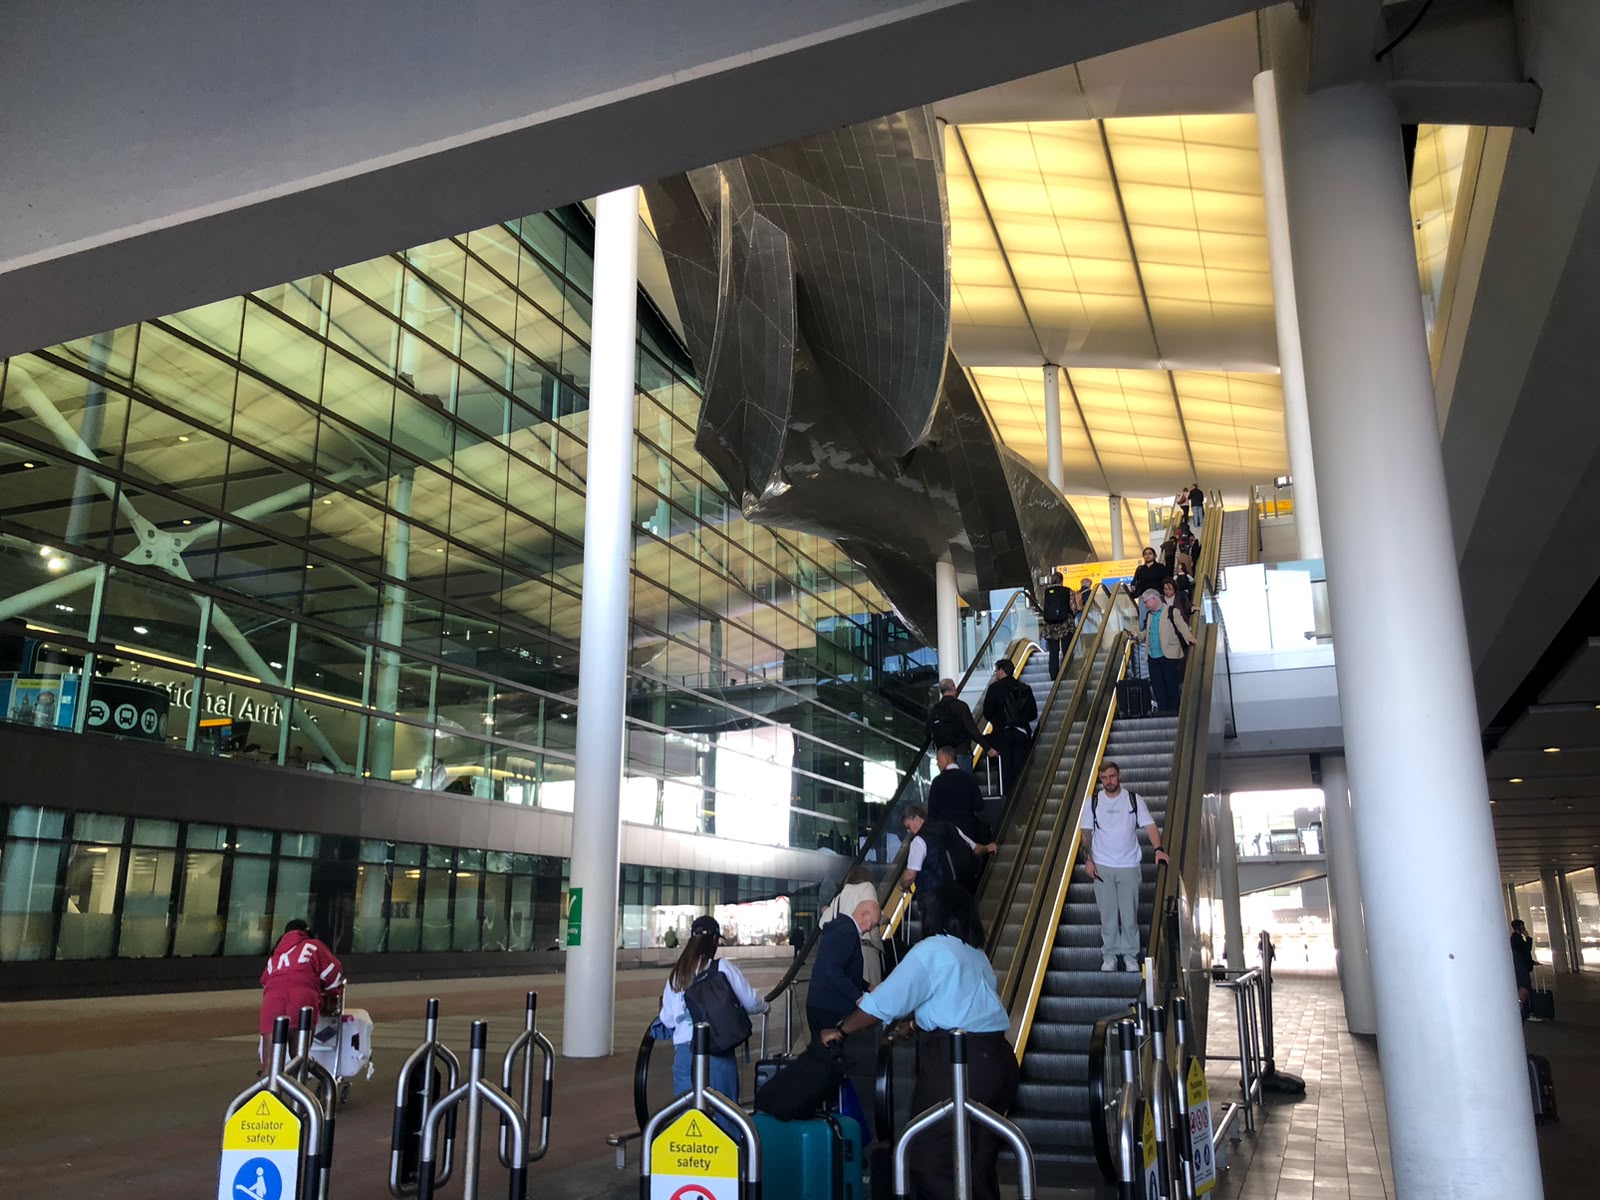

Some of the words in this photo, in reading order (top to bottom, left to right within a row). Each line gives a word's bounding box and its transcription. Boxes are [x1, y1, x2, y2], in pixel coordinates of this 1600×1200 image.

[241, 1120, 284, 1131] Escalator
[246, 1133, 276, 1145] safety
[669, 1141, 719, 1154] Escalator
[677, 1156, 711, 1171] safety
